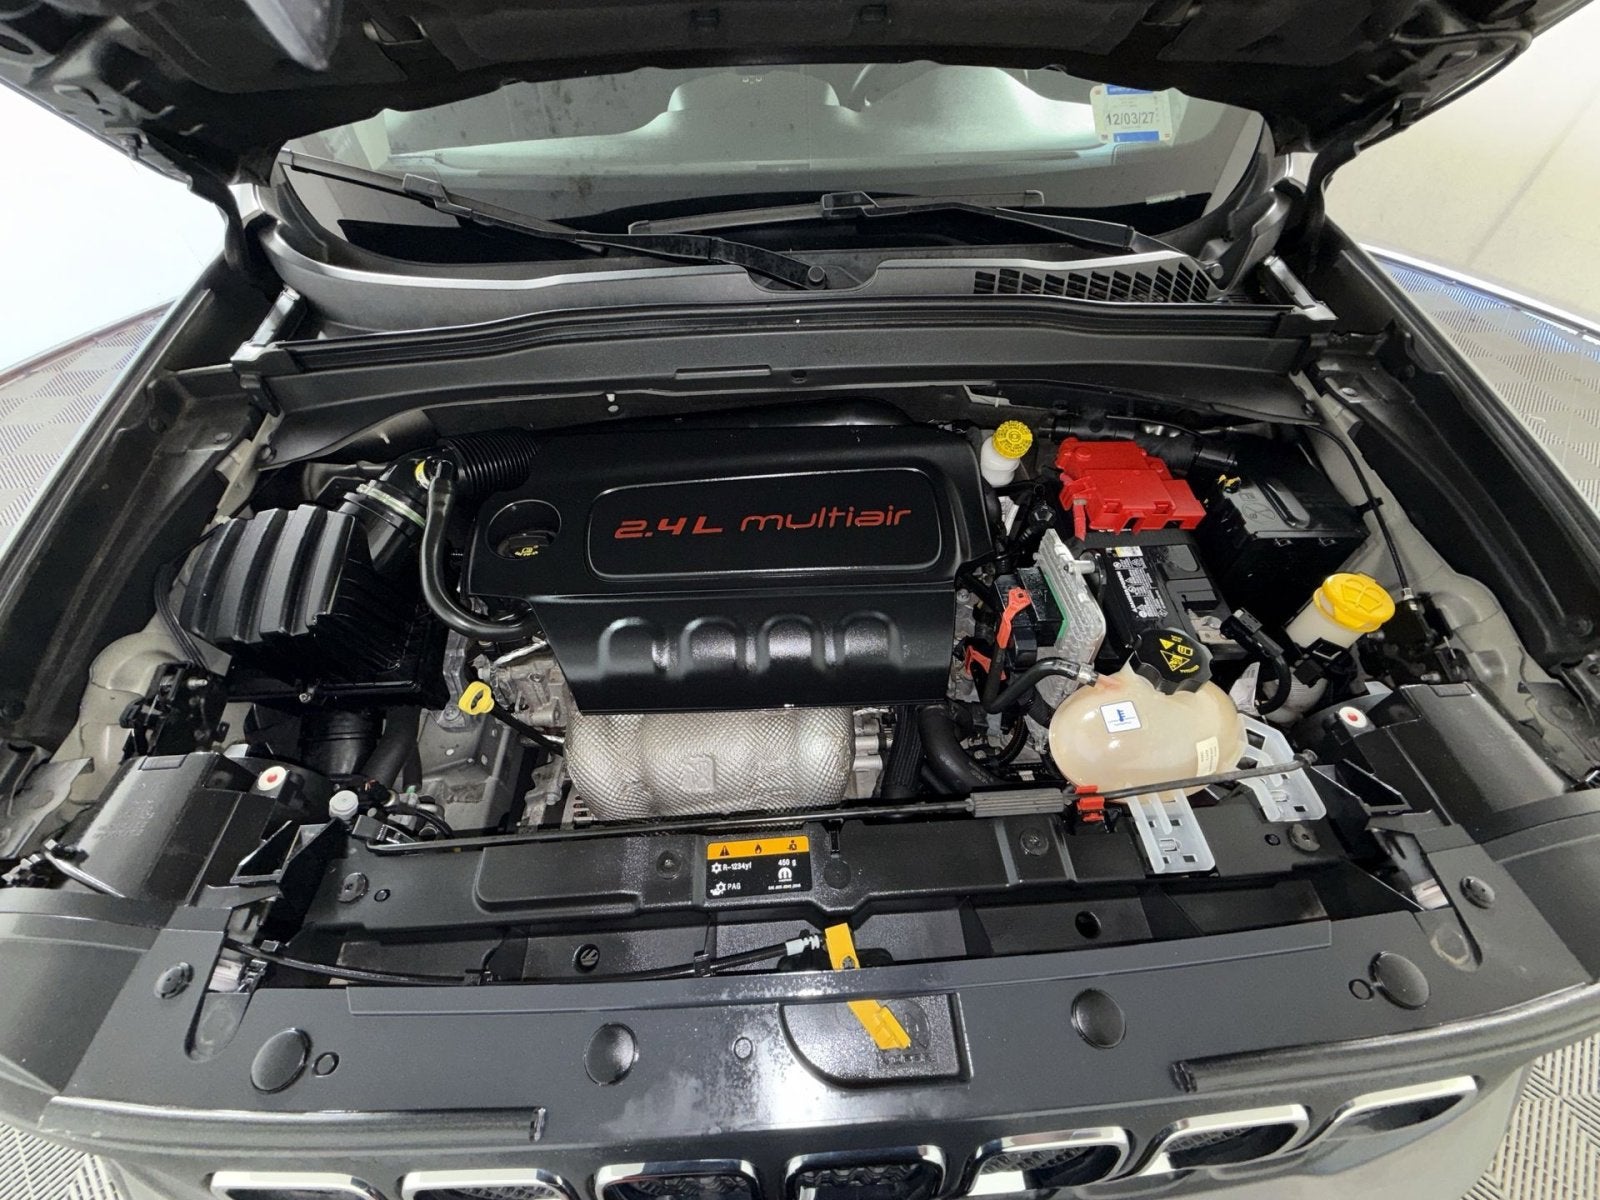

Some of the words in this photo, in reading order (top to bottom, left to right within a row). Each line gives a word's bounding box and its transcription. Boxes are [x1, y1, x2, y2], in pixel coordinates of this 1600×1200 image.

[1105, 111, 1155, 126] 12/03/27
[740, 505, 911, 532] multiair
[778, 858, 790, 866] 450
